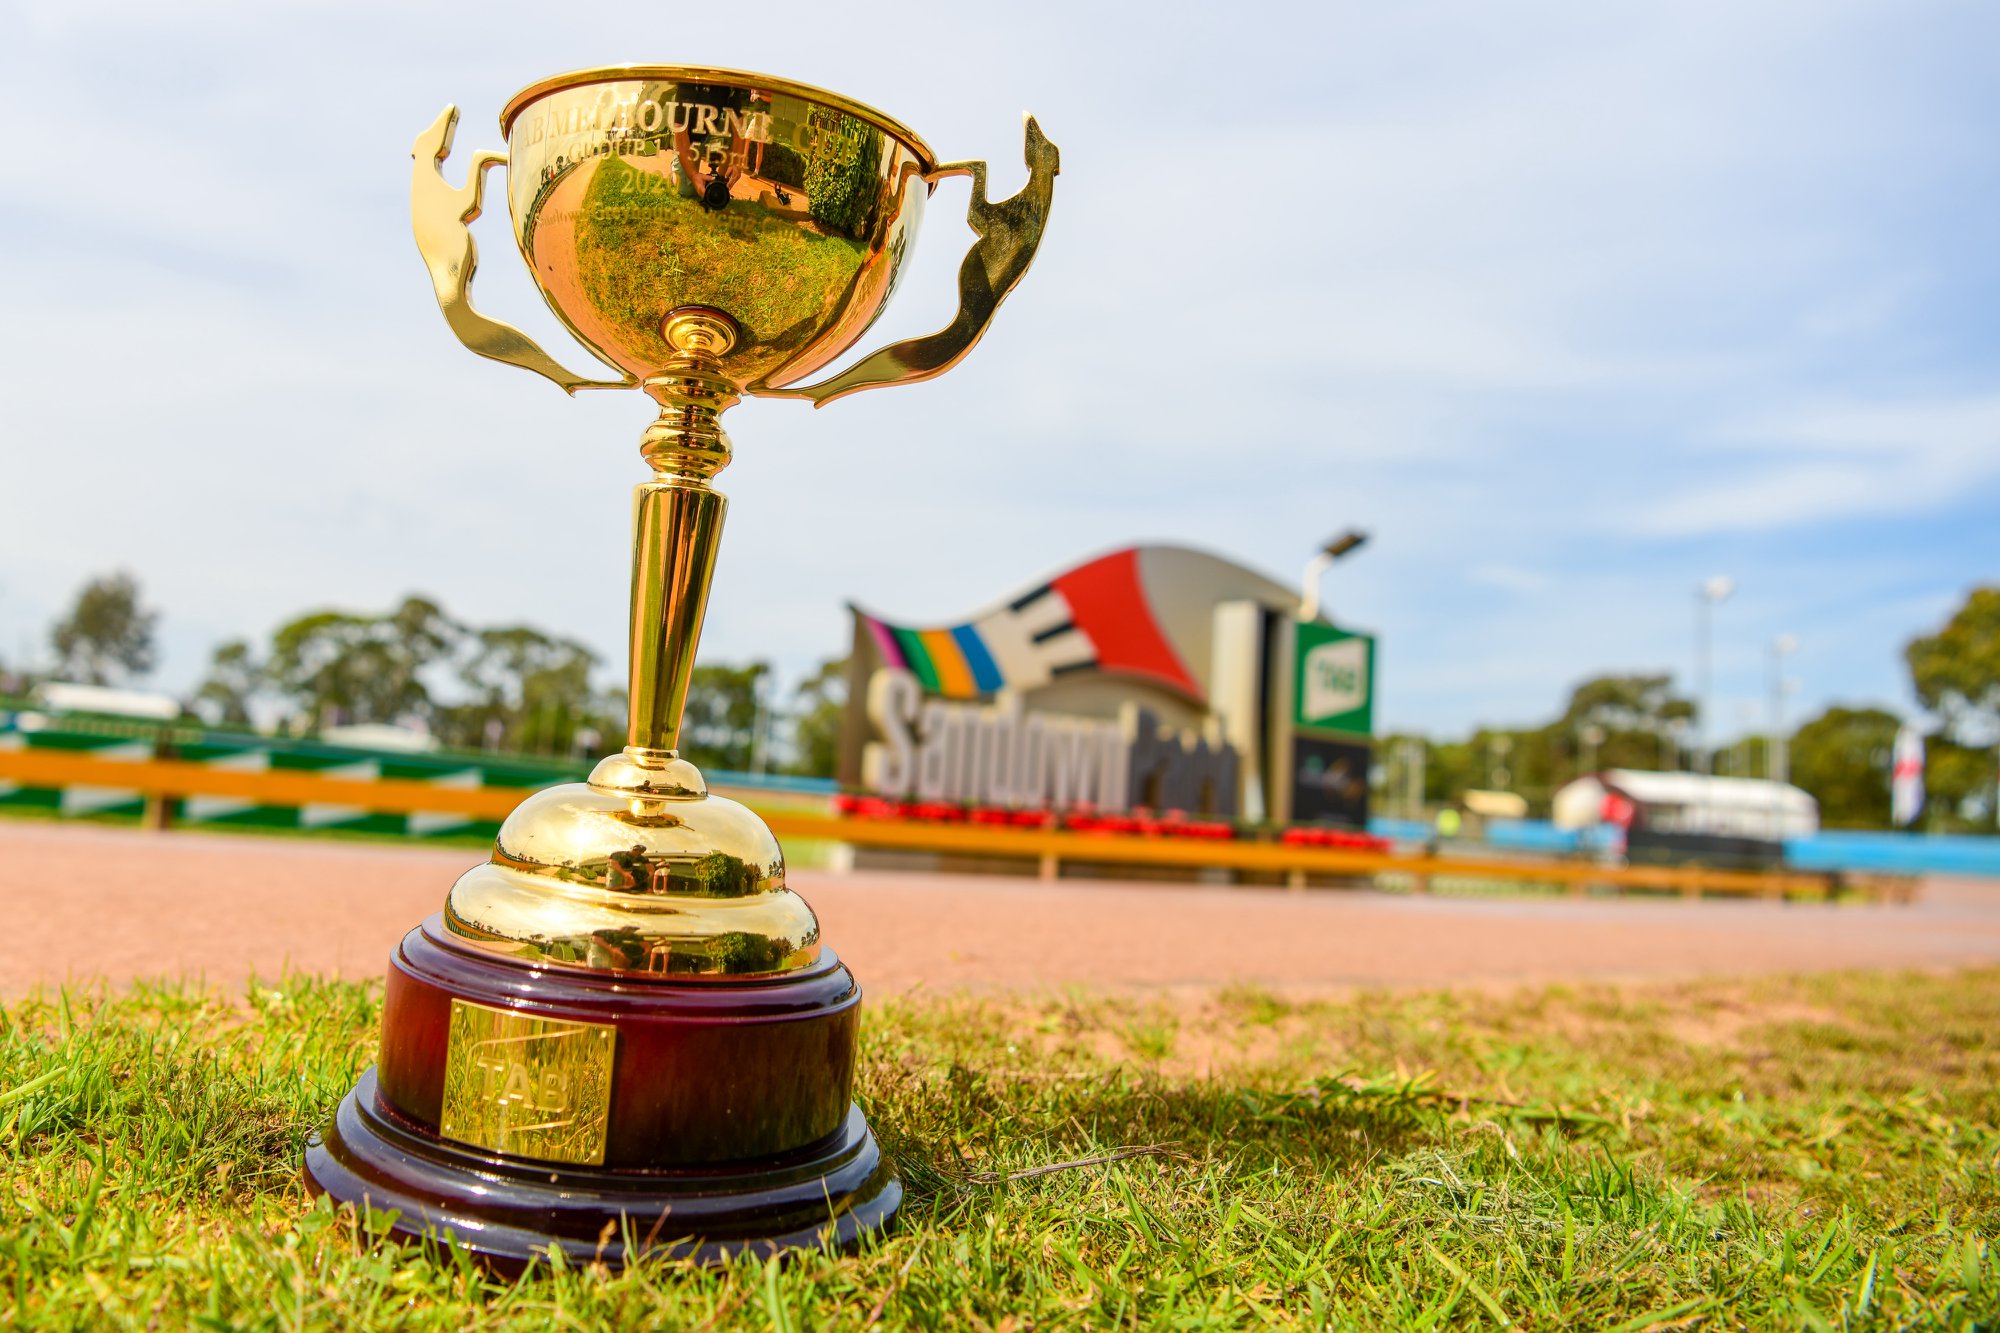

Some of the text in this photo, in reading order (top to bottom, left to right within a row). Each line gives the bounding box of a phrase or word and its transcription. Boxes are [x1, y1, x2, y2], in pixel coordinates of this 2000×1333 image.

[550, 100, 774, 144] MELBOURNE
[793, 122, 861, 166] CUP
[568, 138, 749, 169] GROUP 1 515m
[621, 169, 681, 196] 2020
[863, 668, 1132, 813] Sandown
[476, 1056, 568, 1113] TAB
